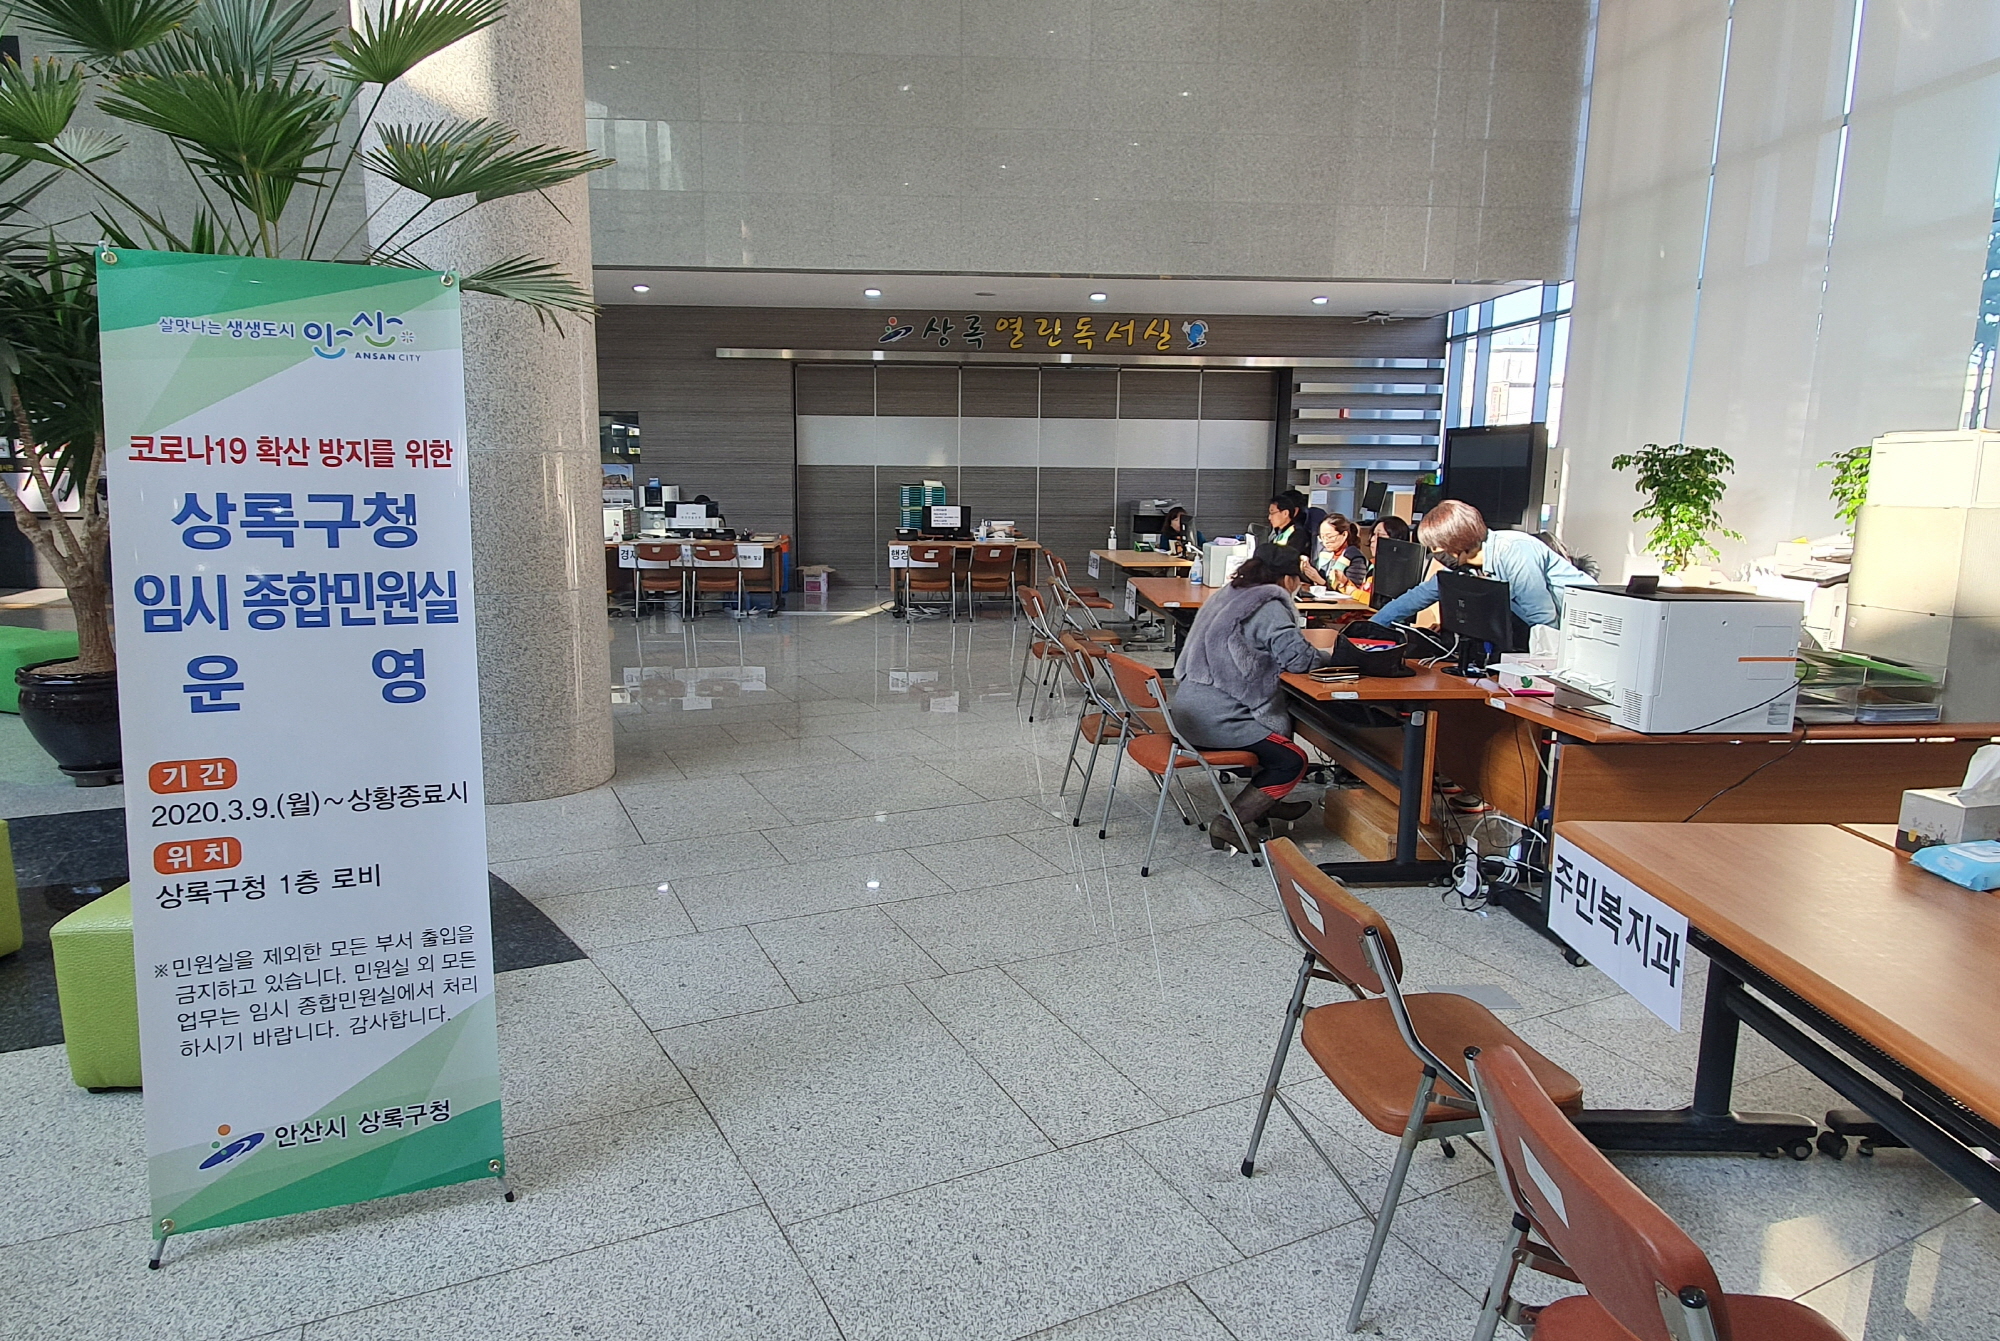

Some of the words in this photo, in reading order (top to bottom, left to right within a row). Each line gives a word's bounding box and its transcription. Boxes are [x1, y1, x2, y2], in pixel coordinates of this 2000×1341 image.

[159, 317, 222, 336] 살맛나는
[227, 320, 295, 338] 생생도시
[922, 314, 987, 350] 상록
[355, 352, 396, 361] ANSAN
[399, 354, 421, 362] CITY
[128, 435, 248, 466] 코로나19
[256, 435, 310, 467] 확산
[319, 438, 395, 468] 방지를
[405, 439, 453, 469] 위한
[171, 492, 419, 550] 상록구청
[134, 573, 229, 633] 임시
[243, 570, 459, 631] 종합민원실
[156, 875, 266, 910] 상록구청
[280, 870, 320, 894] 1층
[332, 864, 381, 890] 로비
[263, 941, 322, 965] 제외한
[330, 937, 368, 957] 모든
[375, 931, 413, 953] 부서
[420, 924, 475, 946] 출입을
[1554, 854, 1681, 988] 주민복지과
[175, 976, 257, 1005] 금지하고
[264, 966, 347, 993] 있습니다.
[353, 957, 410, 983] 민원실
[417, 955, 435, 973] 외
[441, 949, 477, 970] 모든
[176, 1005, 241, 1032] 업무는
[249, 999, 290, 1022] 임시
[298, 981, 435, 1018] 종합민원실에서
[443, 975, 478, 996] 처리
[179, 1032, 244, 1058] 하시기
[252, 1020, 340, 1048] 바랍니다.
[348, 1004, 452, 1036] 감사합니다.
[273, 1115, 347, 1149] 안산시
[357, 1100, 451, 1135] 상록구청
